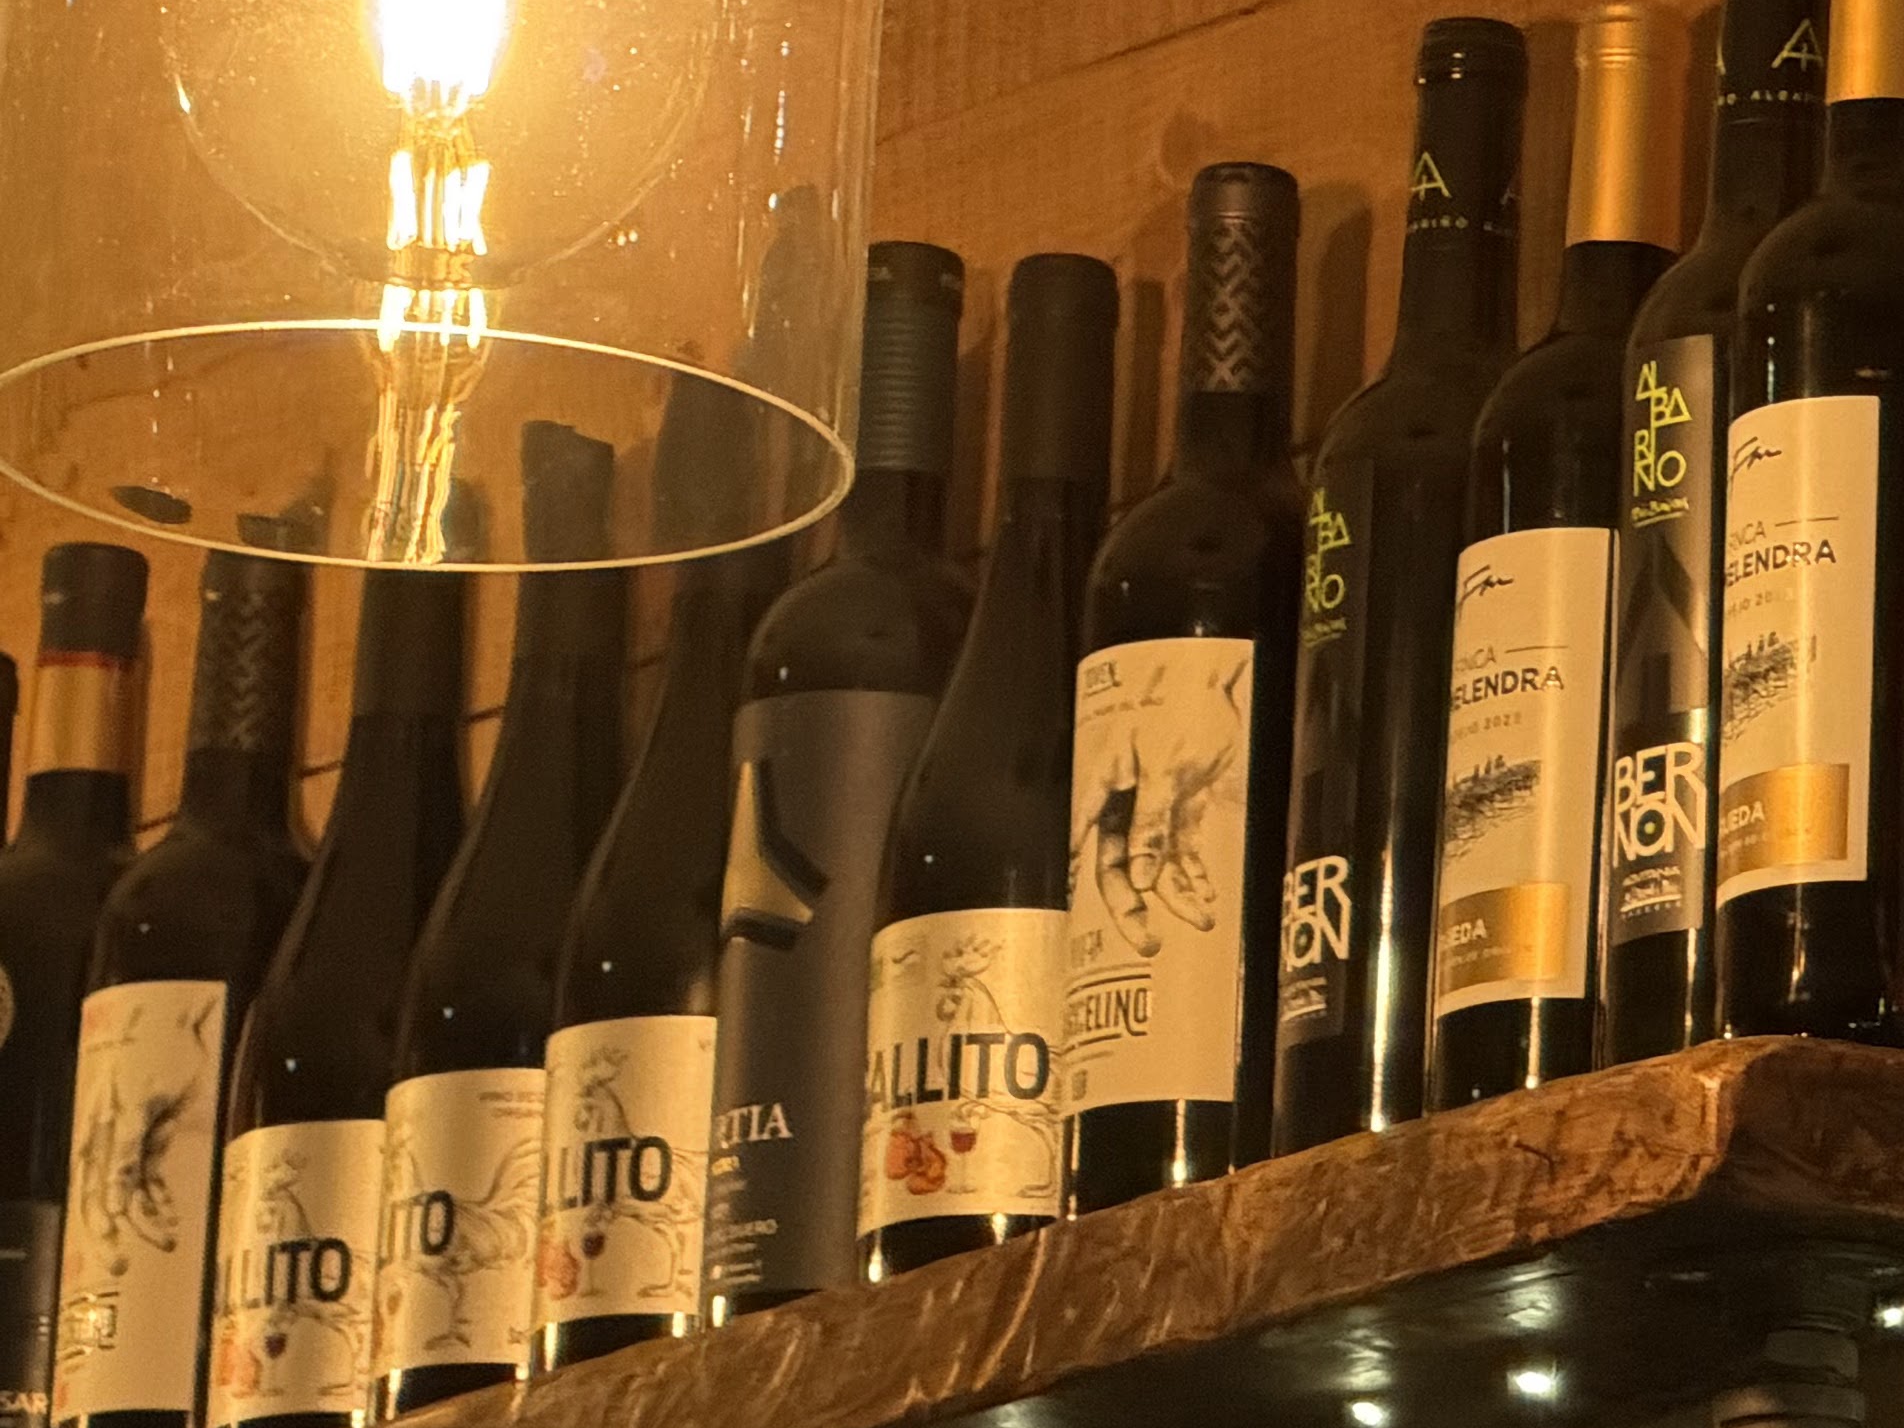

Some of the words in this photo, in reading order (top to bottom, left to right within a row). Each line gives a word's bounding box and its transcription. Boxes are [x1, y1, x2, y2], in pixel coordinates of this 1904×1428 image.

[1725, 538, 1837, 587] ELENDRA
[1450, 666, 1565, 712] ELENDRA
[871, 1032, 1051, 1113] ALLITO
